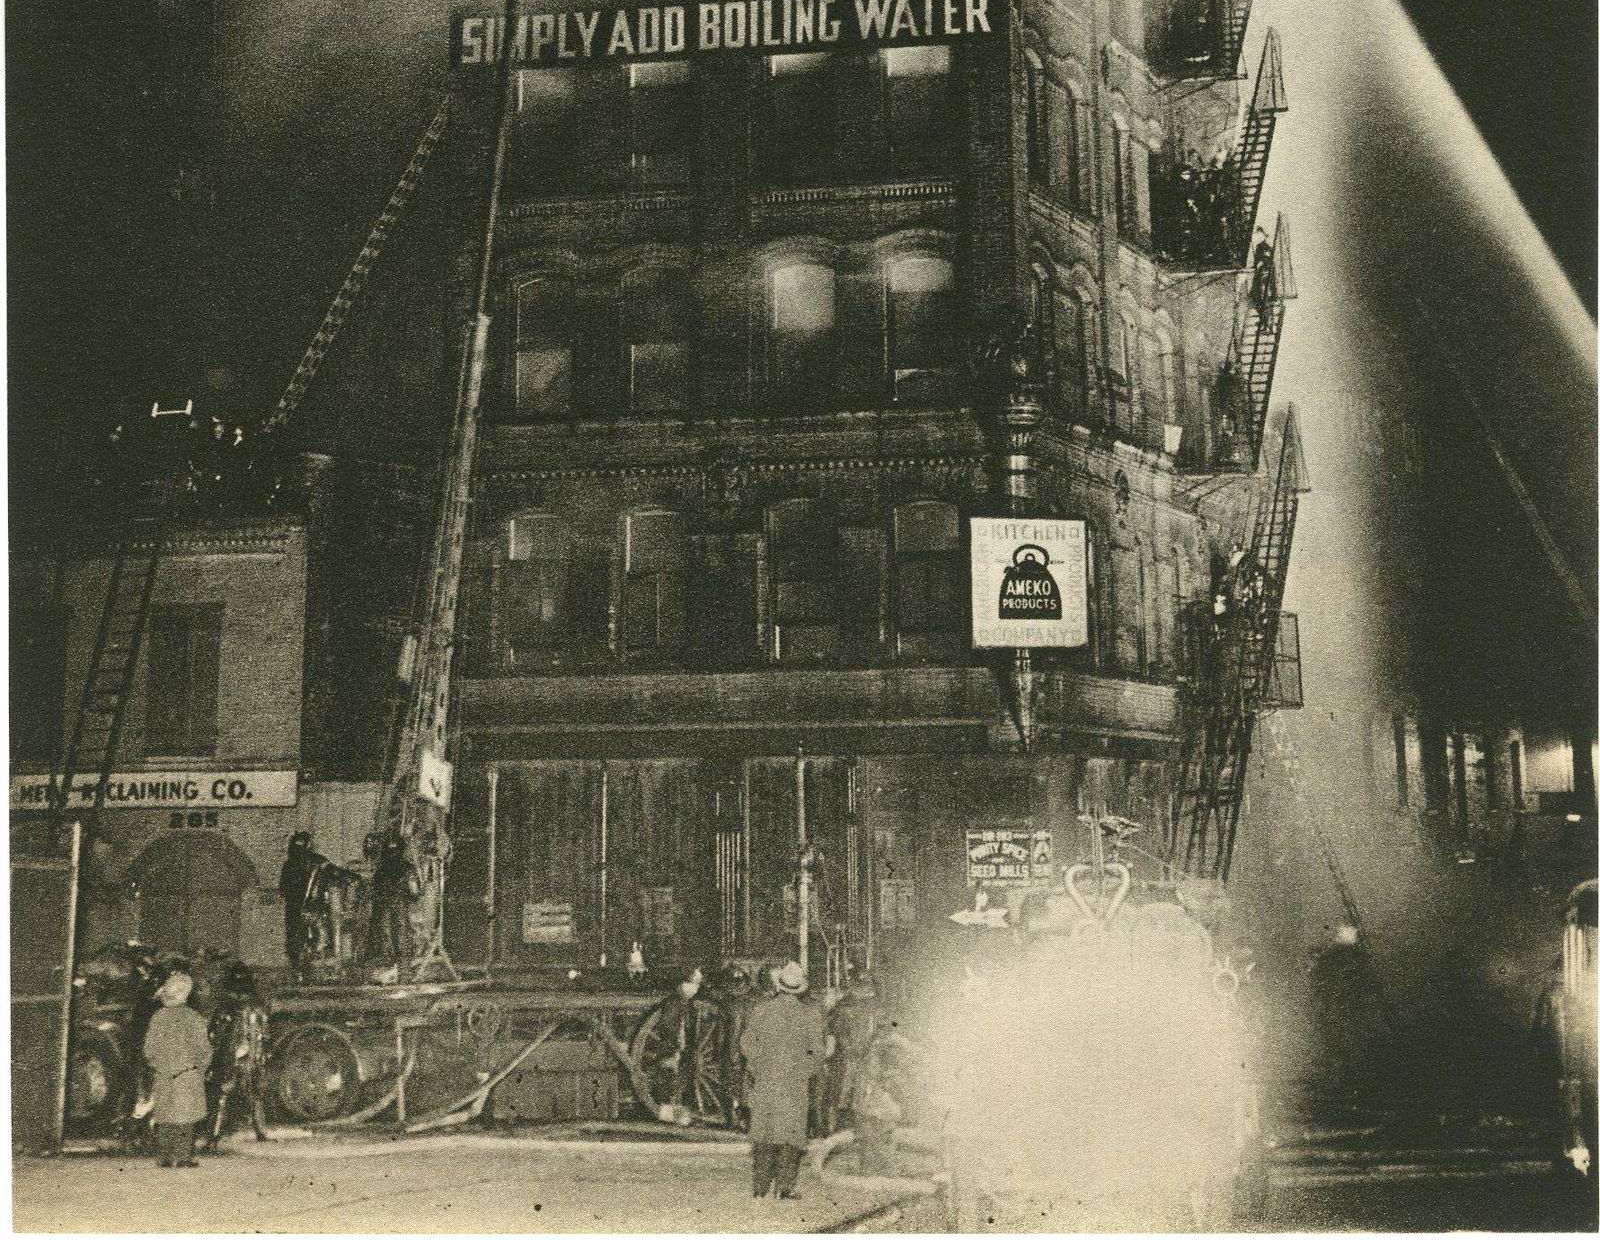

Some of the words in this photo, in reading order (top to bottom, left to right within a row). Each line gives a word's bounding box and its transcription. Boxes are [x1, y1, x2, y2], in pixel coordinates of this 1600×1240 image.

[607, 5, 686, 56] ADD
[1006, 579, 1051, 596] AMEKO
[1002, 598, 1057, 610] PRODUCTS
[211, 779, 253, 801] CO.
